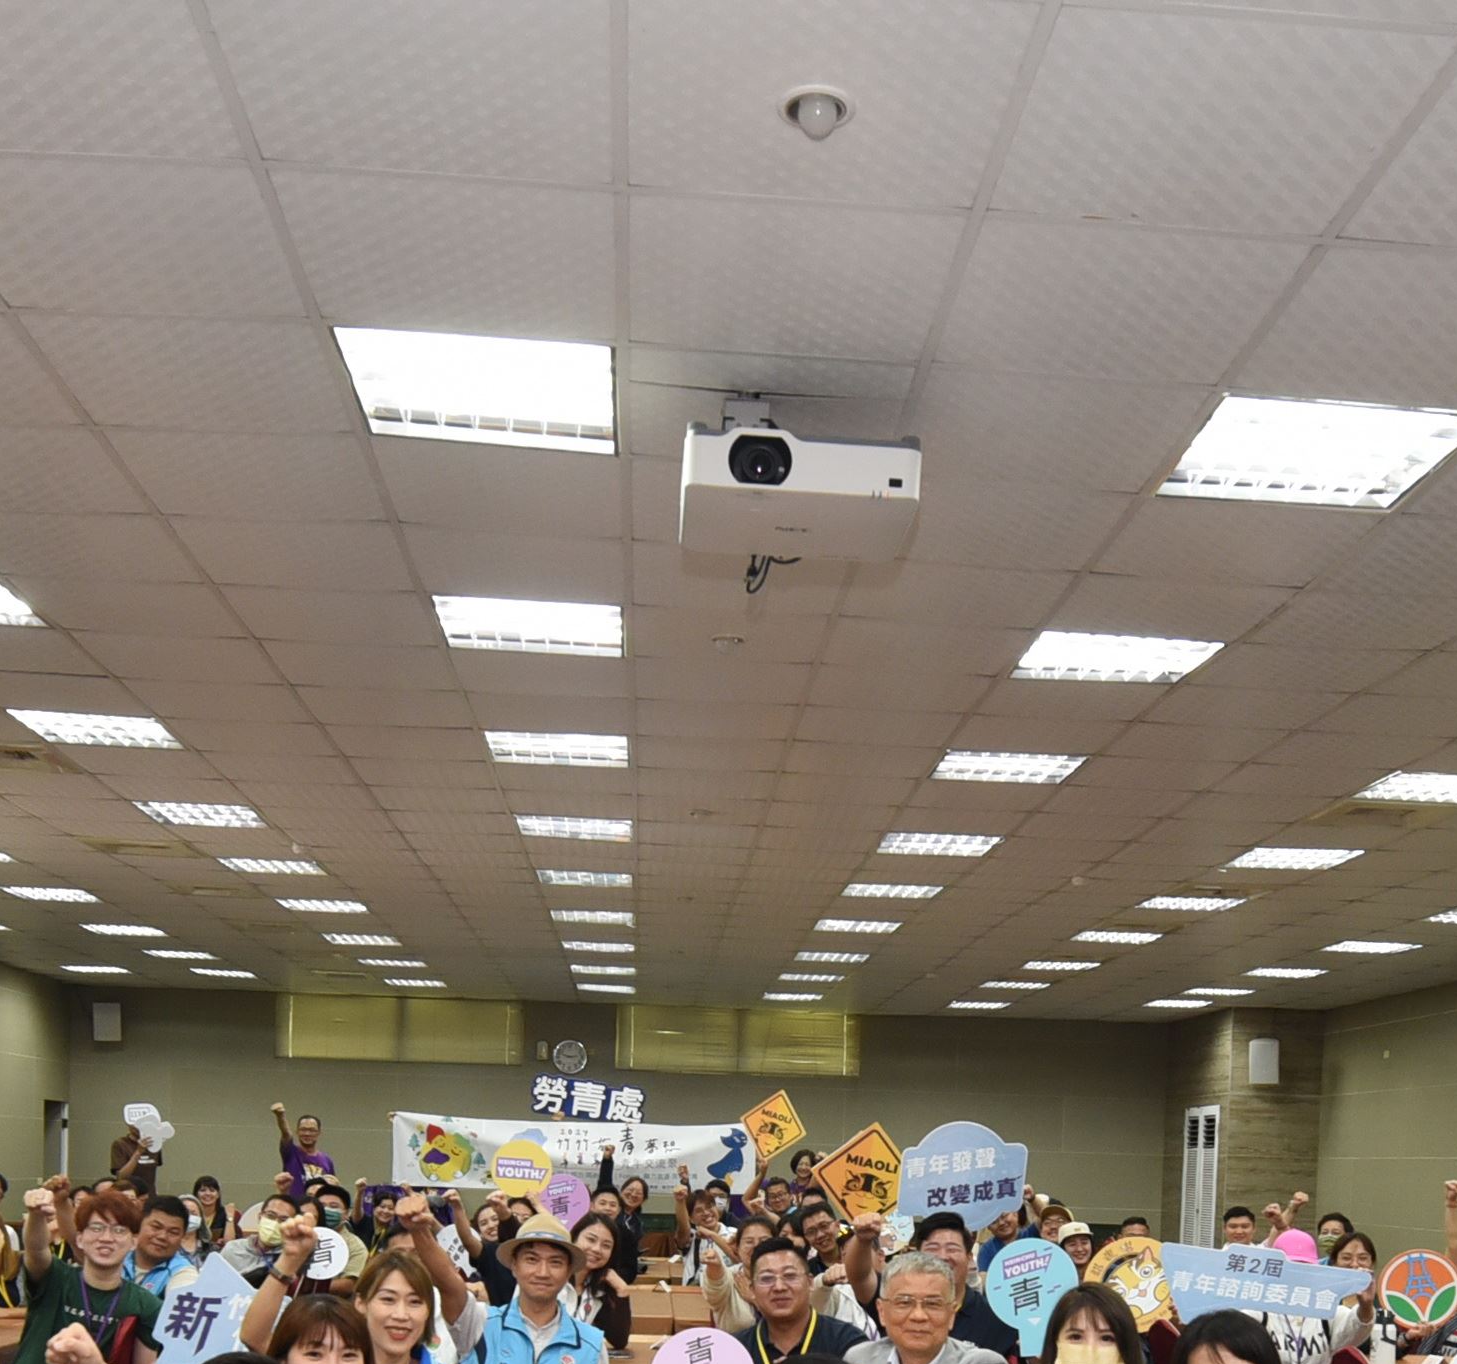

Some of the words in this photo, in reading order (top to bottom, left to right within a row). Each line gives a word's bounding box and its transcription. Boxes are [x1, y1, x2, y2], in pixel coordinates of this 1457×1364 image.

[533, 1076, 644, 1123] 勞青處
[761, 1108, 793, 1125] MIAOLI
[497, 1166, 546, 1180] YOUTH!
[846, 1153, 899, 1175] MIAOLI
[906, 1147, 996, 1178] 青年發聲
[927, 1177, 1017, 1208] 改變成真
[1004, 1256, 1050, 1278] YOUTH!
[1225, 1253, 1284, 1278] 第2屆
[1009, 1276, 1043, 1316] 青
[1171, 1270, 1338, 1311] 青年諮詢委員會
